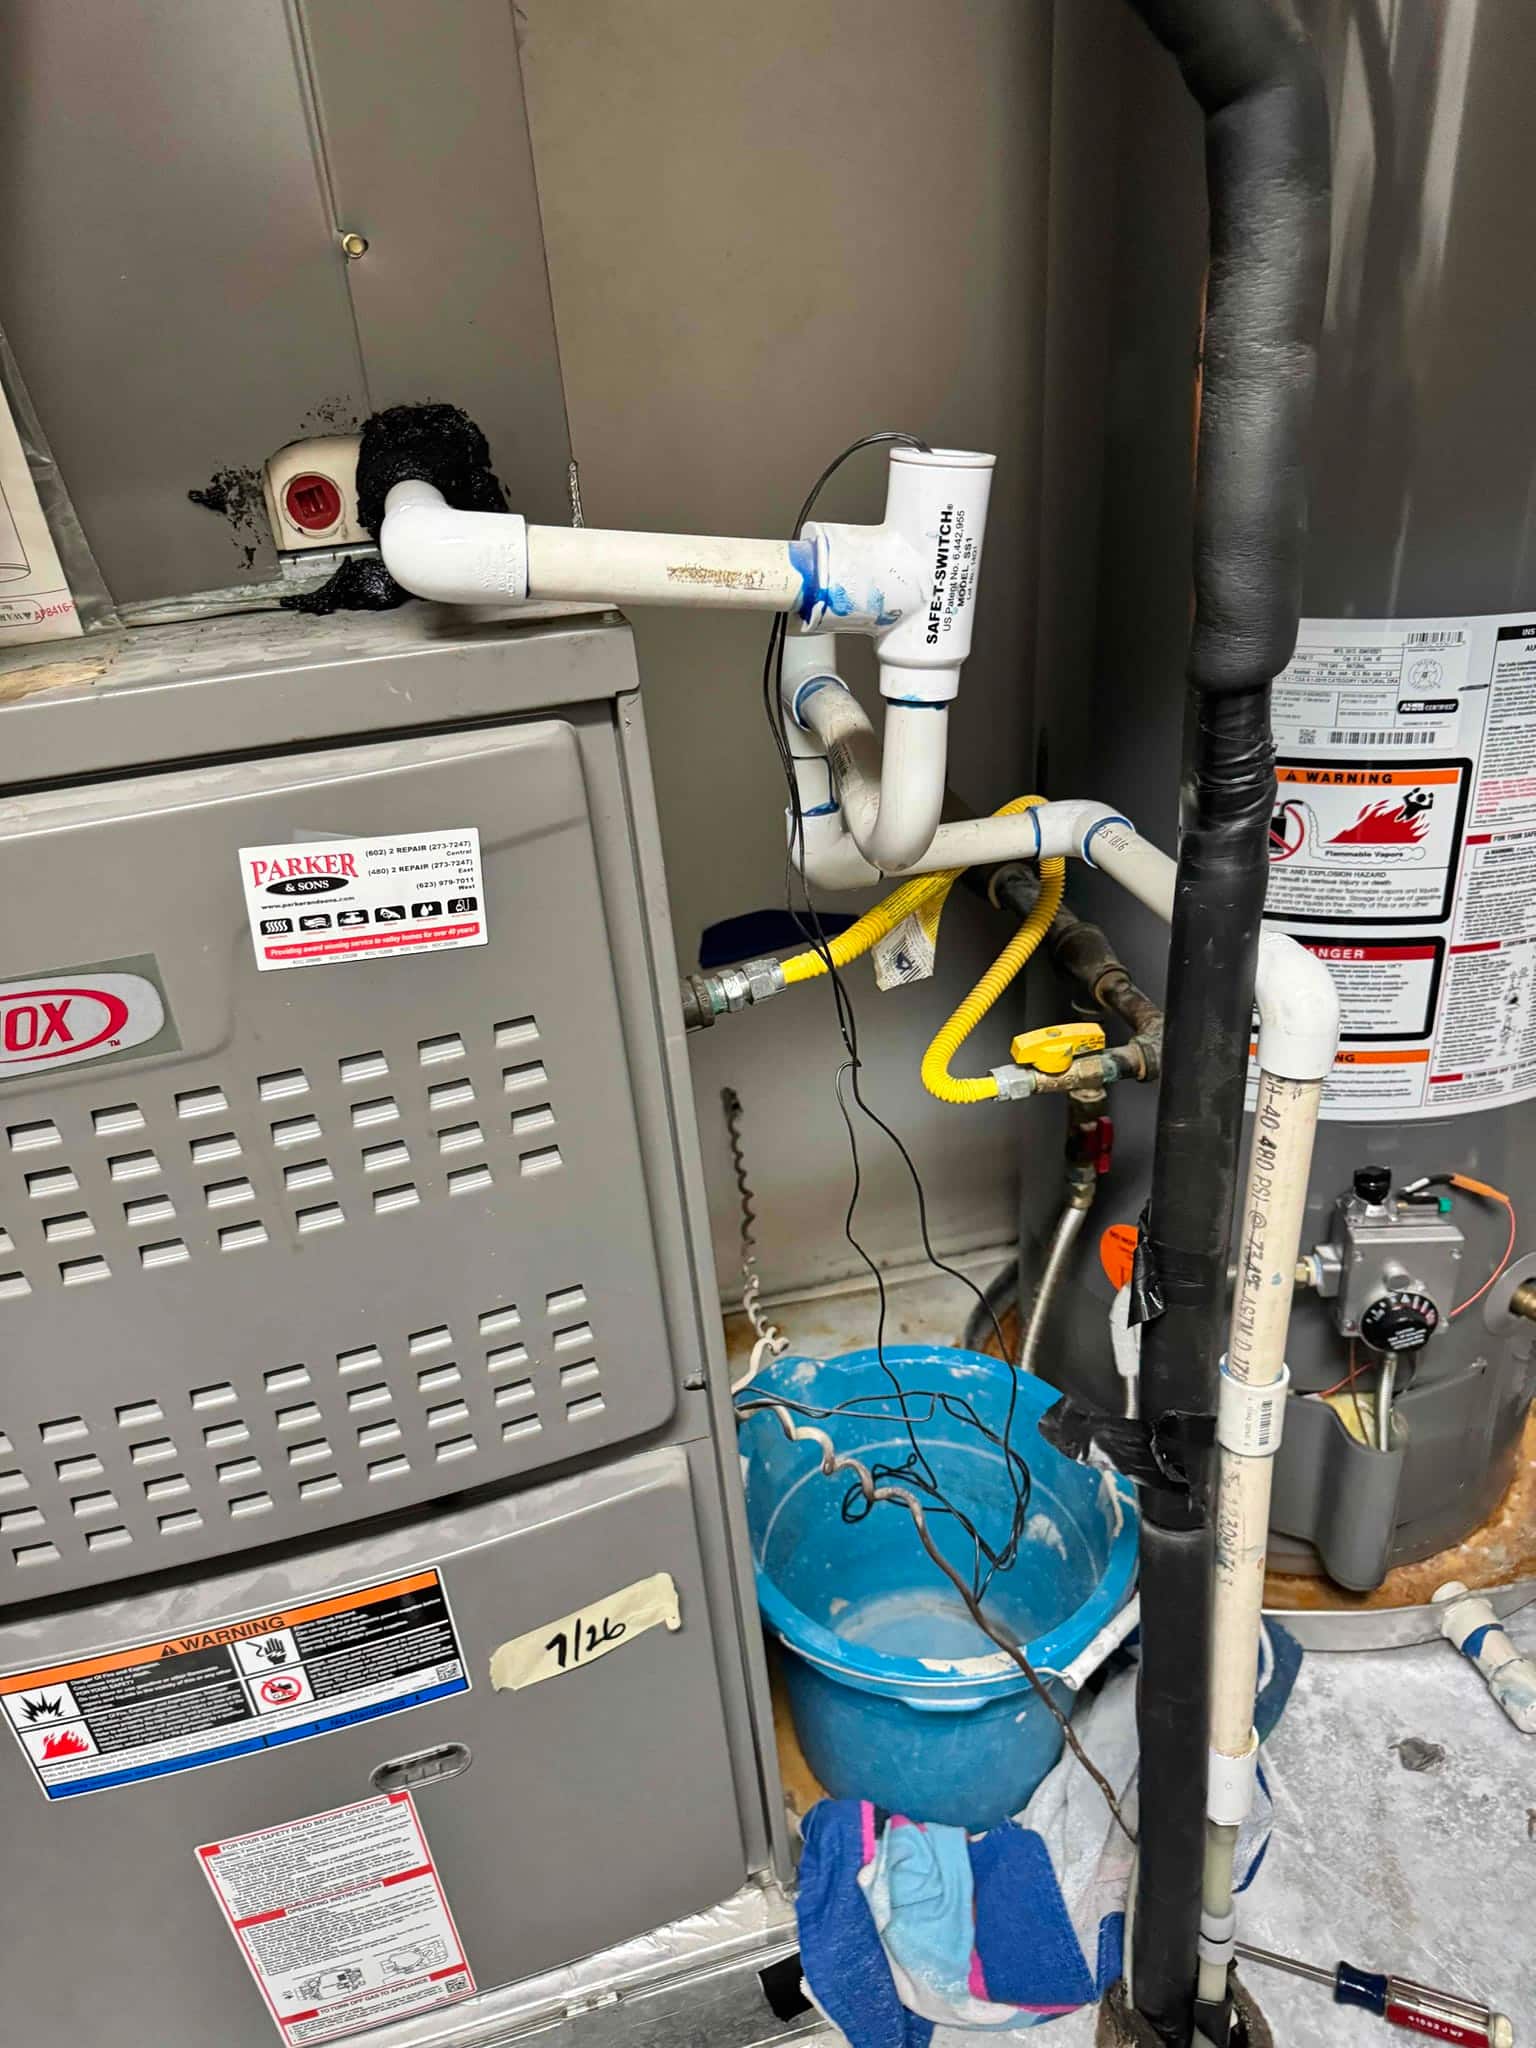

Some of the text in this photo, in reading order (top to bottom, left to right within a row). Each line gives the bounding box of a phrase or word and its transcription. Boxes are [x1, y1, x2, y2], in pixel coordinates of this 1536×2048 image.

[943, 510, 966, 632] US Patent No. 6,442,955
[958, 566, 969, 608] MODEL
[964, 537, 973, 560] SS1
[1306, 773, 1393, 784] WARNING
[366, 848, 387, 858] (602)
[396, 845, 427, 854] REPAIR
[429, 840, 471, 852] (273-7247)
[446, 848, 472, 857] Central
[250, 852, 359, 888] PARKER
[392, 866, 397, 874] 2
[399, 864, 428, 872] REPAIR
[431, 858, 473, 871] (273-7247)
[1308, 870, 1352, 878] EXPLOSION
[285, 879, 330, 892] & SONS
[416, 878, 474, 890] (623) 979-7011
[270, 945, 302, 956] Providing
[350, 937, 373, 947] service
[401, 931, 422, 941] homes
[423, 930, 431, 938] for
[433, 928, 447, 937] over
[181, 1616, 286, 1651] WARNING
[546, 1618, 626, 1668] 7/26
[74, 1678, 134, 1697] FOR YOUR SAFETY
[221, 1799, 388, 1851] FOR YOUR SAFETY READ BEFORE OPERATING
[286, 1882, 382, 1914] OPERATING INSTRUCTIONS
[330, 2001, 349, 2011] TURN
[349, 1997, 363, 2005] OFF
[363, 1992, 379, 2001] GAS
[389, 1977, 428, 1993] APPLIANCE
